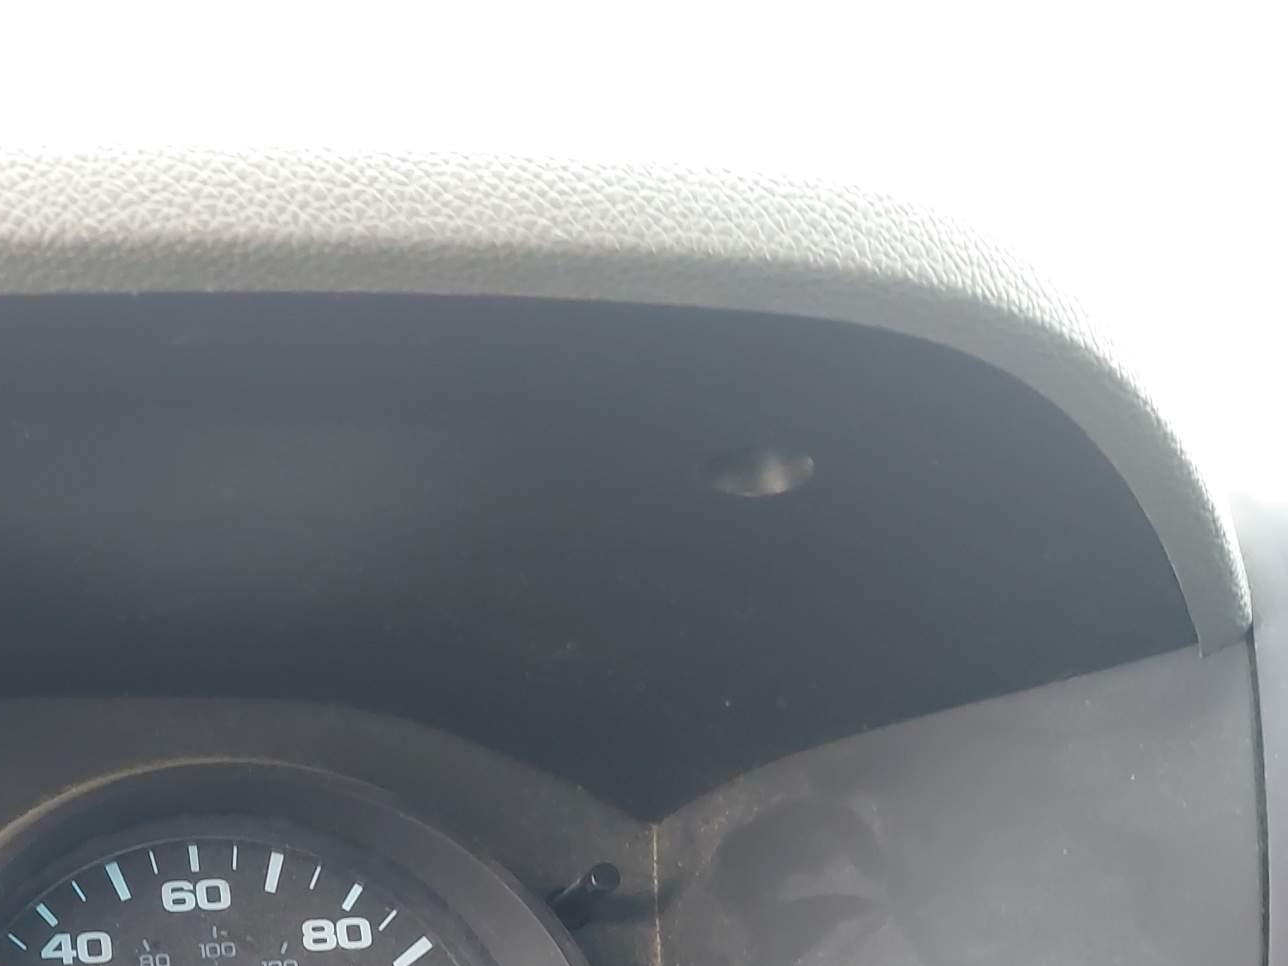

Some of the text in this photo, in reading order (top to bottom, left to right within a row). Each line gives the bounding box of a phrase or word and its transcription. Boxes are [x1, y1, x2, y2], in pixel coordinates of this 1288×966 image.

[161, 878, 232, 913] 60
[40, 930, 113, 965] 40
[198, 942, 237, 959] 100
[301, 917, 373, 953] 80
